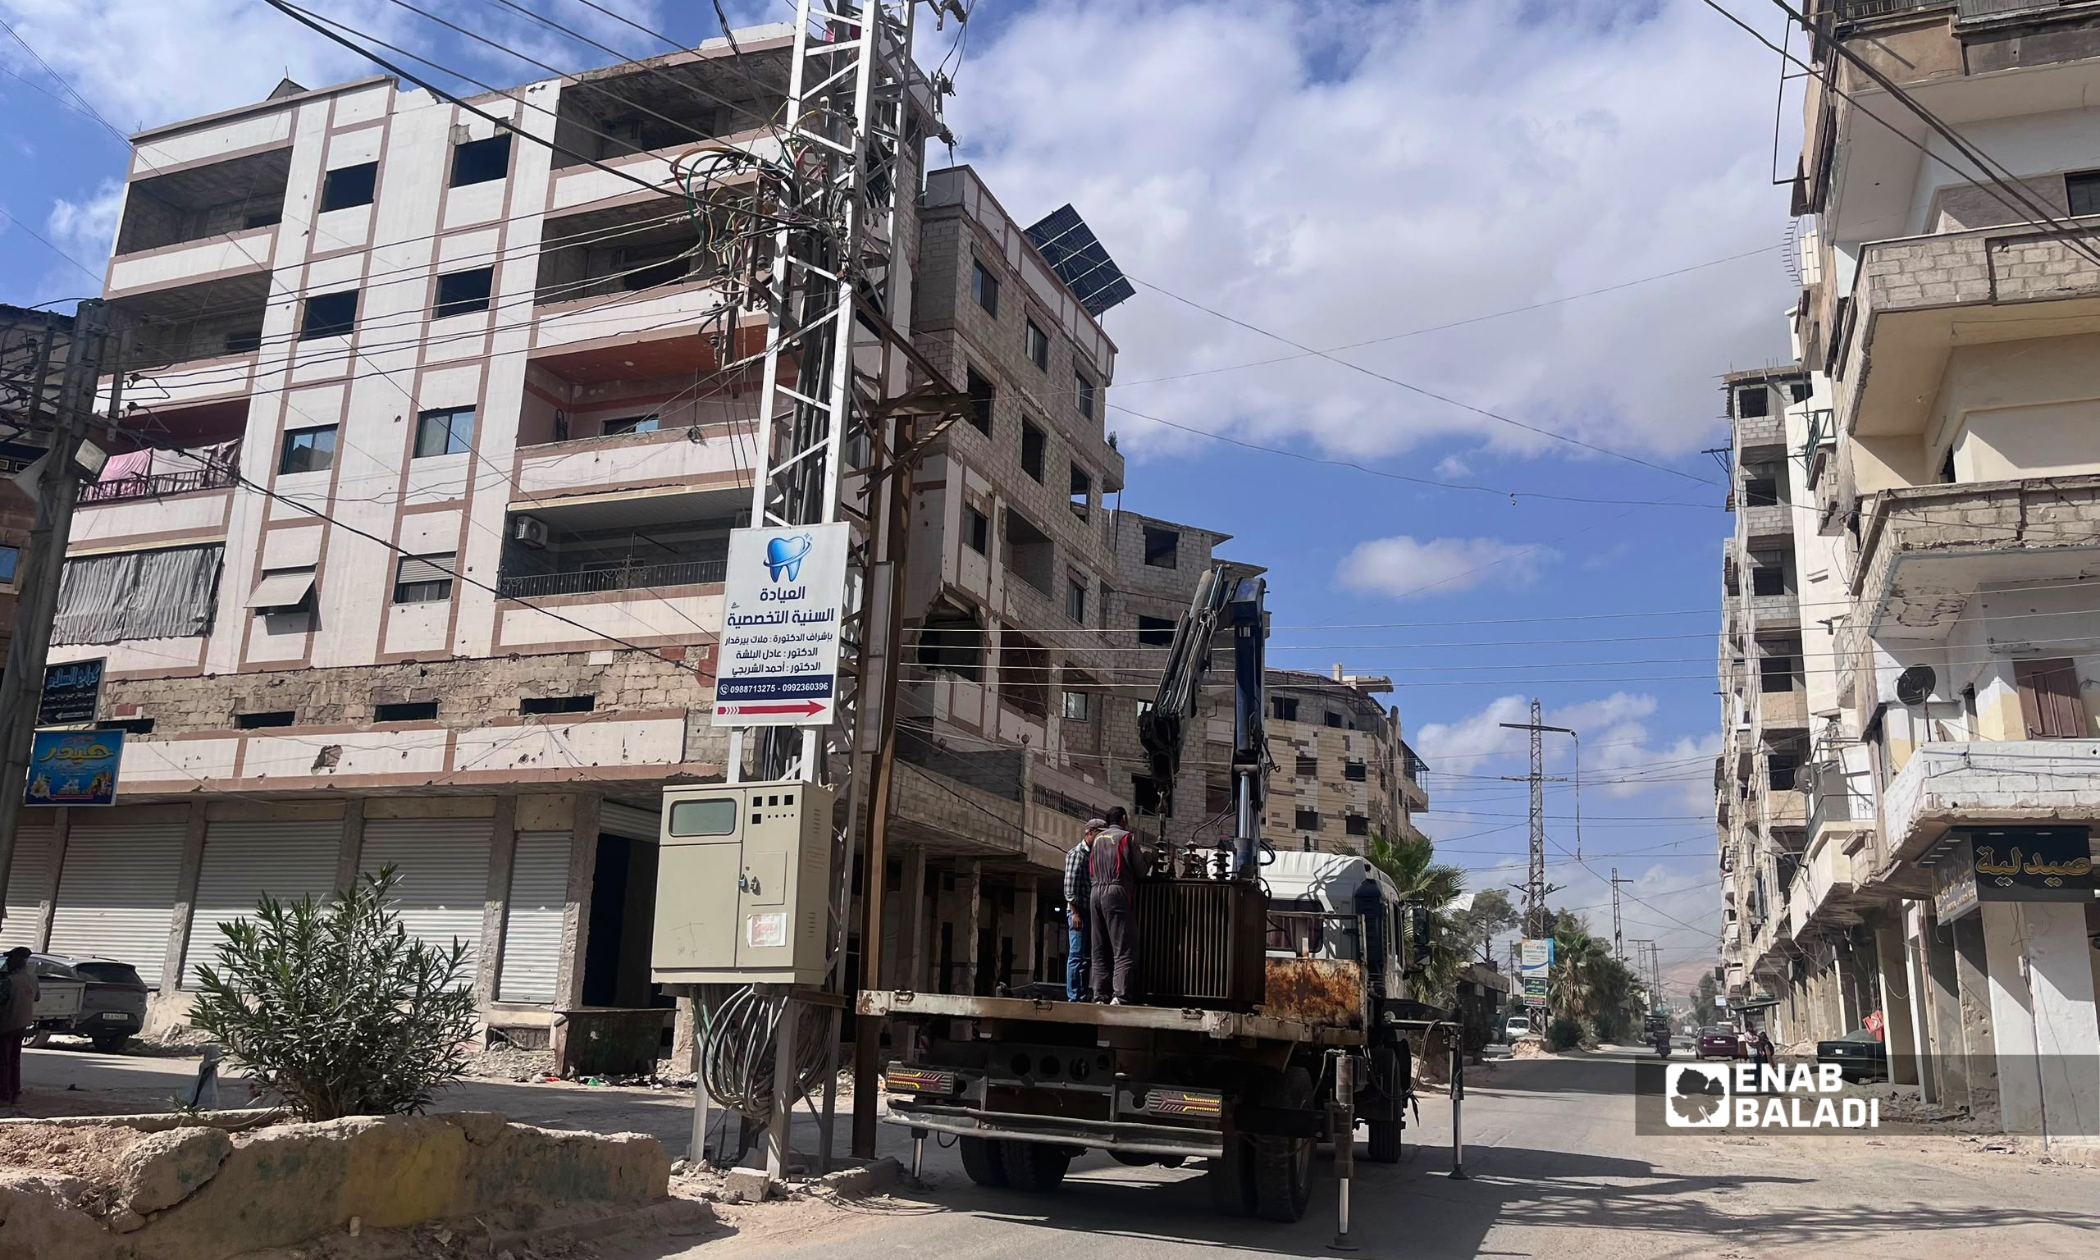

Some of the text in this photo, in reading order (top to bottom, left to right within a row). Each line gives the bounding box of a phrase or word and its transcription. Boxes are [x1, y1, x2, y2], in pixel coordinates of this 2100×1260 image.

[760, 586, 806, 604] العيادة
[727, 608, 835, 629] السنية التخصصية
[773, 633, 805, 645] الدكتورة
[806, 631, 833, 643] بإشراف
[762, 649, 782, 660] عادل
[787, 647, 818, 659] الدكتور
[765, 661, 785, 673] أحمد
[790, 662, 821, 673] الدكتور
[730, 684, 776, 694] 0988713275
[1975, 845, 2092, 887] صيدلية
